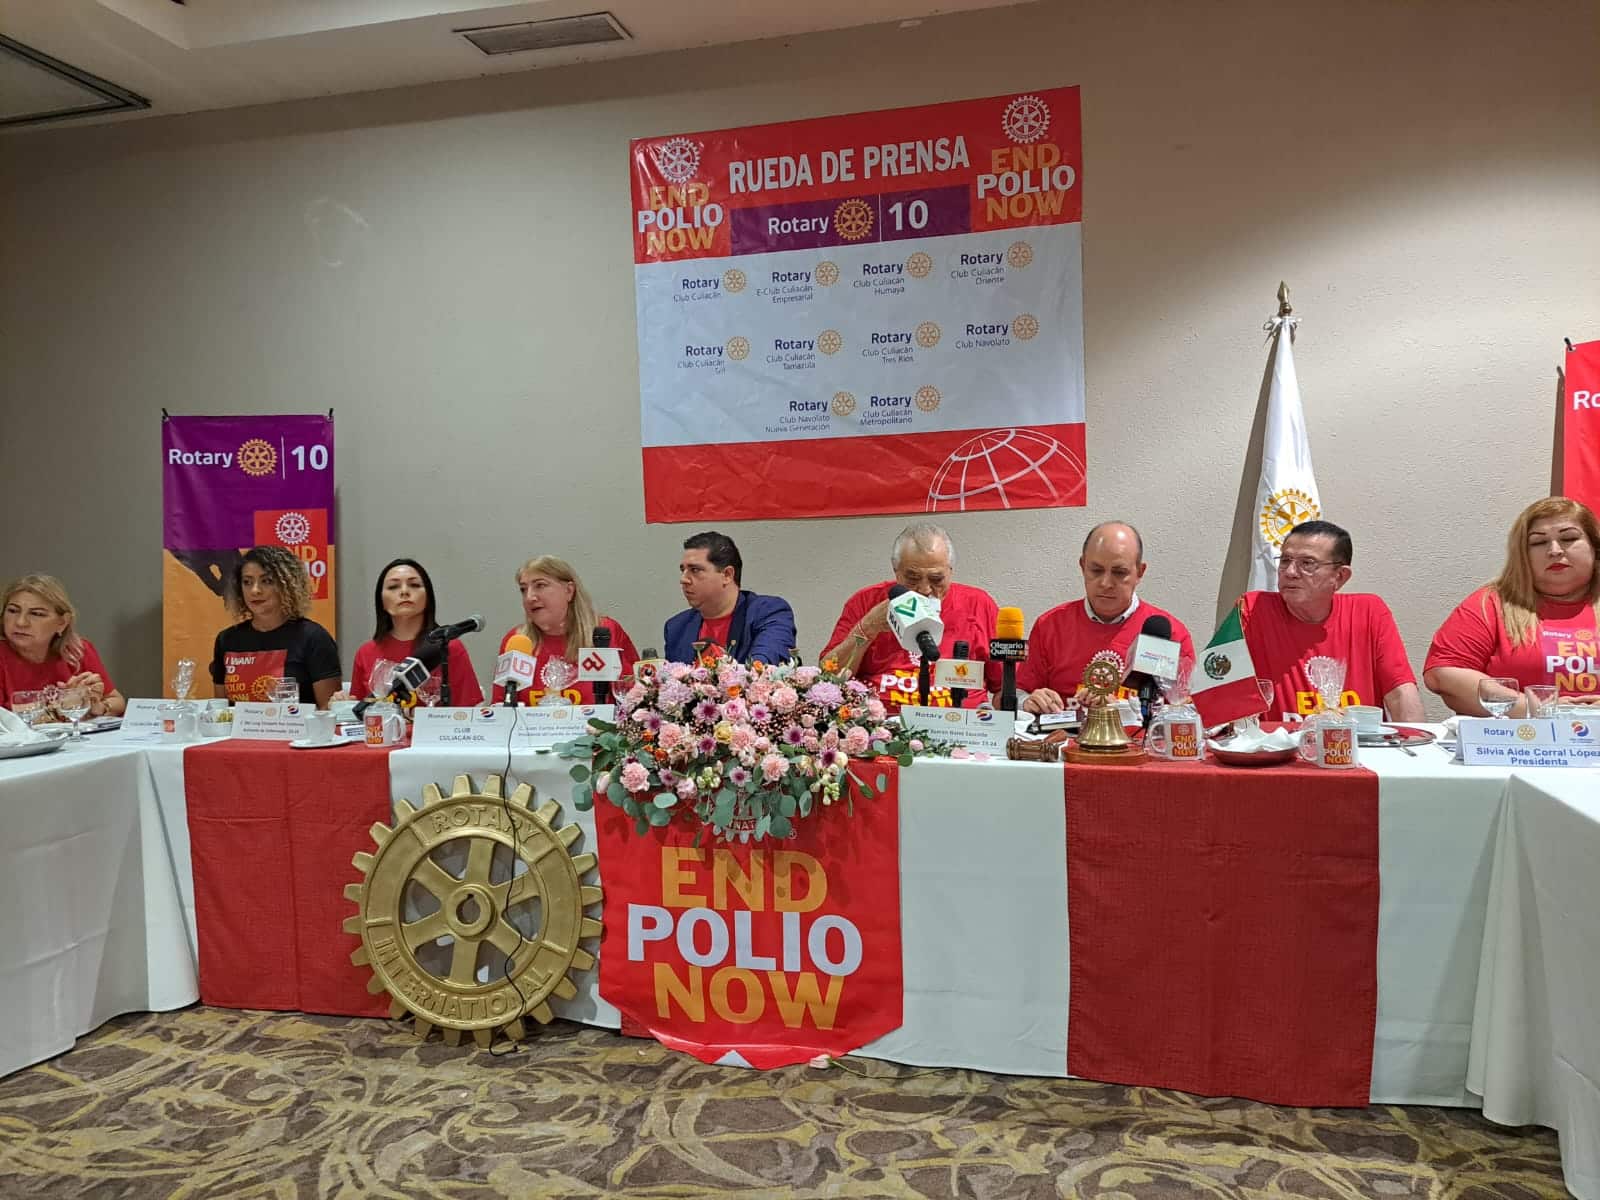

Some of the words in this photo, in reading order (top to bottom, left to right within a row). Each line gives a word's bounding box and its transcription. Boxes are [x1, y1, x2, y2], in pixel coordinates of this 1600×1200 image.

[728, 153, 814, 195] RUEDA
[821, 148, 856, 184] DE
[863, 135, 970, 180] PRENSA
[991, 143, 1061, 175] END
[976, 164, 1076, 200] POLIO
[649, 182, 710, 211] END
[986, 190, 1065, 222] NOW
[637, 203, 724, 233] POLIO
[767, 215, 830, 236] Rotary
[888, 199, 929, 231] 10
[646, 226, 716, 256] NOW
[960, 252, 1003, 265] Rotary
[862, 262, 904, 276] Rotary
[682, 278, 720, 290] Rotary
[772, 271, 812, 284] Rotary
[874, 286, 905, 296] Humaya
[966, 323, 1009, 336] Rotary
[775, 339, 815, 351] Rotary
[871, 332, 912, 345] Rotary
[685, 345, 724, 357] Rotary
[789, 400, 829, 413] Rotary
[870, 395, 911, 408] Rotary
[860, 416, 913, 426] Metropolitano
[168, 448, 233, 468] Rotary
[291, 444, 329, 471] 10
[1557, 641, 1598, 657] EN
[230, 656, 256, 665] WANT
[1546, 655, 1600, 674] POL
[1555, 672, 1598, 692] NO
[1483, 727, 1515, 737] Rotary
[1476, 747, 1504, 756] Silvia
[1533, 748, 1567, 757] Corral
[1511, 757, 1569, 766] Presidenta
[431, 805, 544, 844] ROTARY
[661, 846, 828, 913] END
[627, 903, 863, 977] POLIO
[653, 962, 845, 1031] NOW
